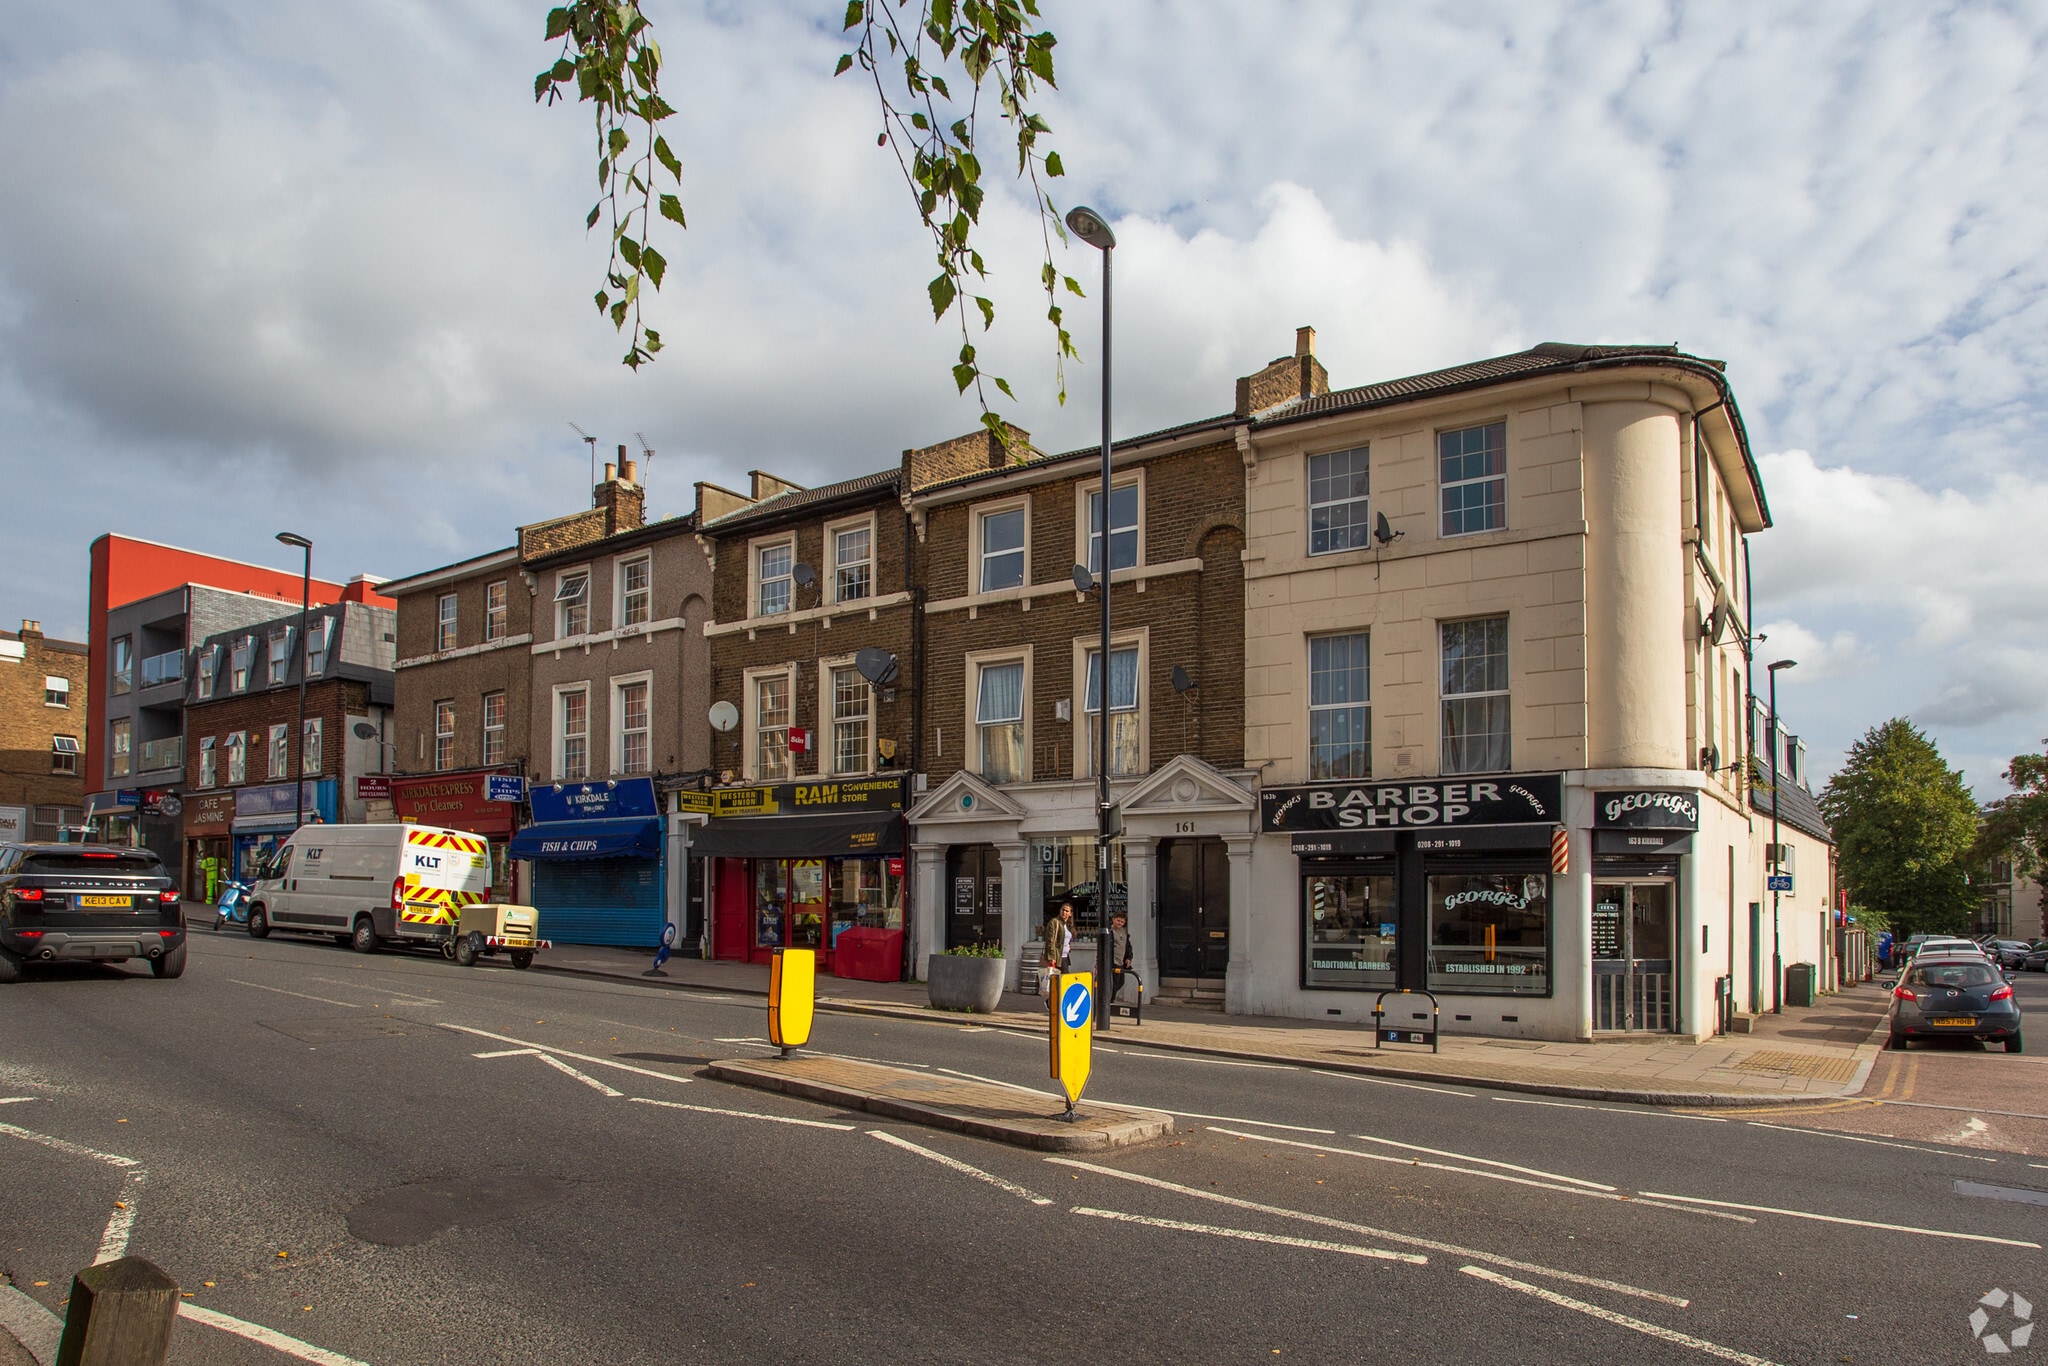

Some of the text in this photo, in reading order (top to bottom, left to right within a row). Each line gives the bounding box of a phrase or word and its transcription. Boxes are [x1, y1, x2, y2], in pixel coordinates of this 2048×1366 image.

[401, 782, 474, 799] KIRKDALE EXPRESS
[842, 780, 899, 791] CONVENIENCE
[575, 792, 609, 805] KIRKDALE
[721, 791, 756, 800] WESTERN
[795, 784, 838, 805] RAM
[842, 794, 868, 802] STORE
[1309, 782, 1502, 809] BARBER
[1509, 784, 1546, 816] GEORGES
[200, 799, 218, 809] CAFE
[413, 802, 428, 815] Dry
[430, 800, 463, 812] Cleaners
[1605, 792, 1697, 822] GEORGES
[194, 811, 224, 823] JASMINE
[1338, 804, 1470, 827] SHOP
[1176, 821, 1195, 833] 161
[542, 840, 597, 852] FISH & CHIPS
[1628, 837, 1637, 845] 163
[1642, 837, 1664, 845] KIRKDALE
[306, 848, 323, 860] KLT
[1036, 844, 1059, 861] 161
[415, 855, 441, 869] KLT
[85, 896, 128, 905] KE13 CAV
[1444, 890, 1529, 910] GEORGES
[1313, 960, 1391, 971] TRADITIONAL BARBERS
[1445, 963, 1526, 974] ESTABLISHED IN 1992
